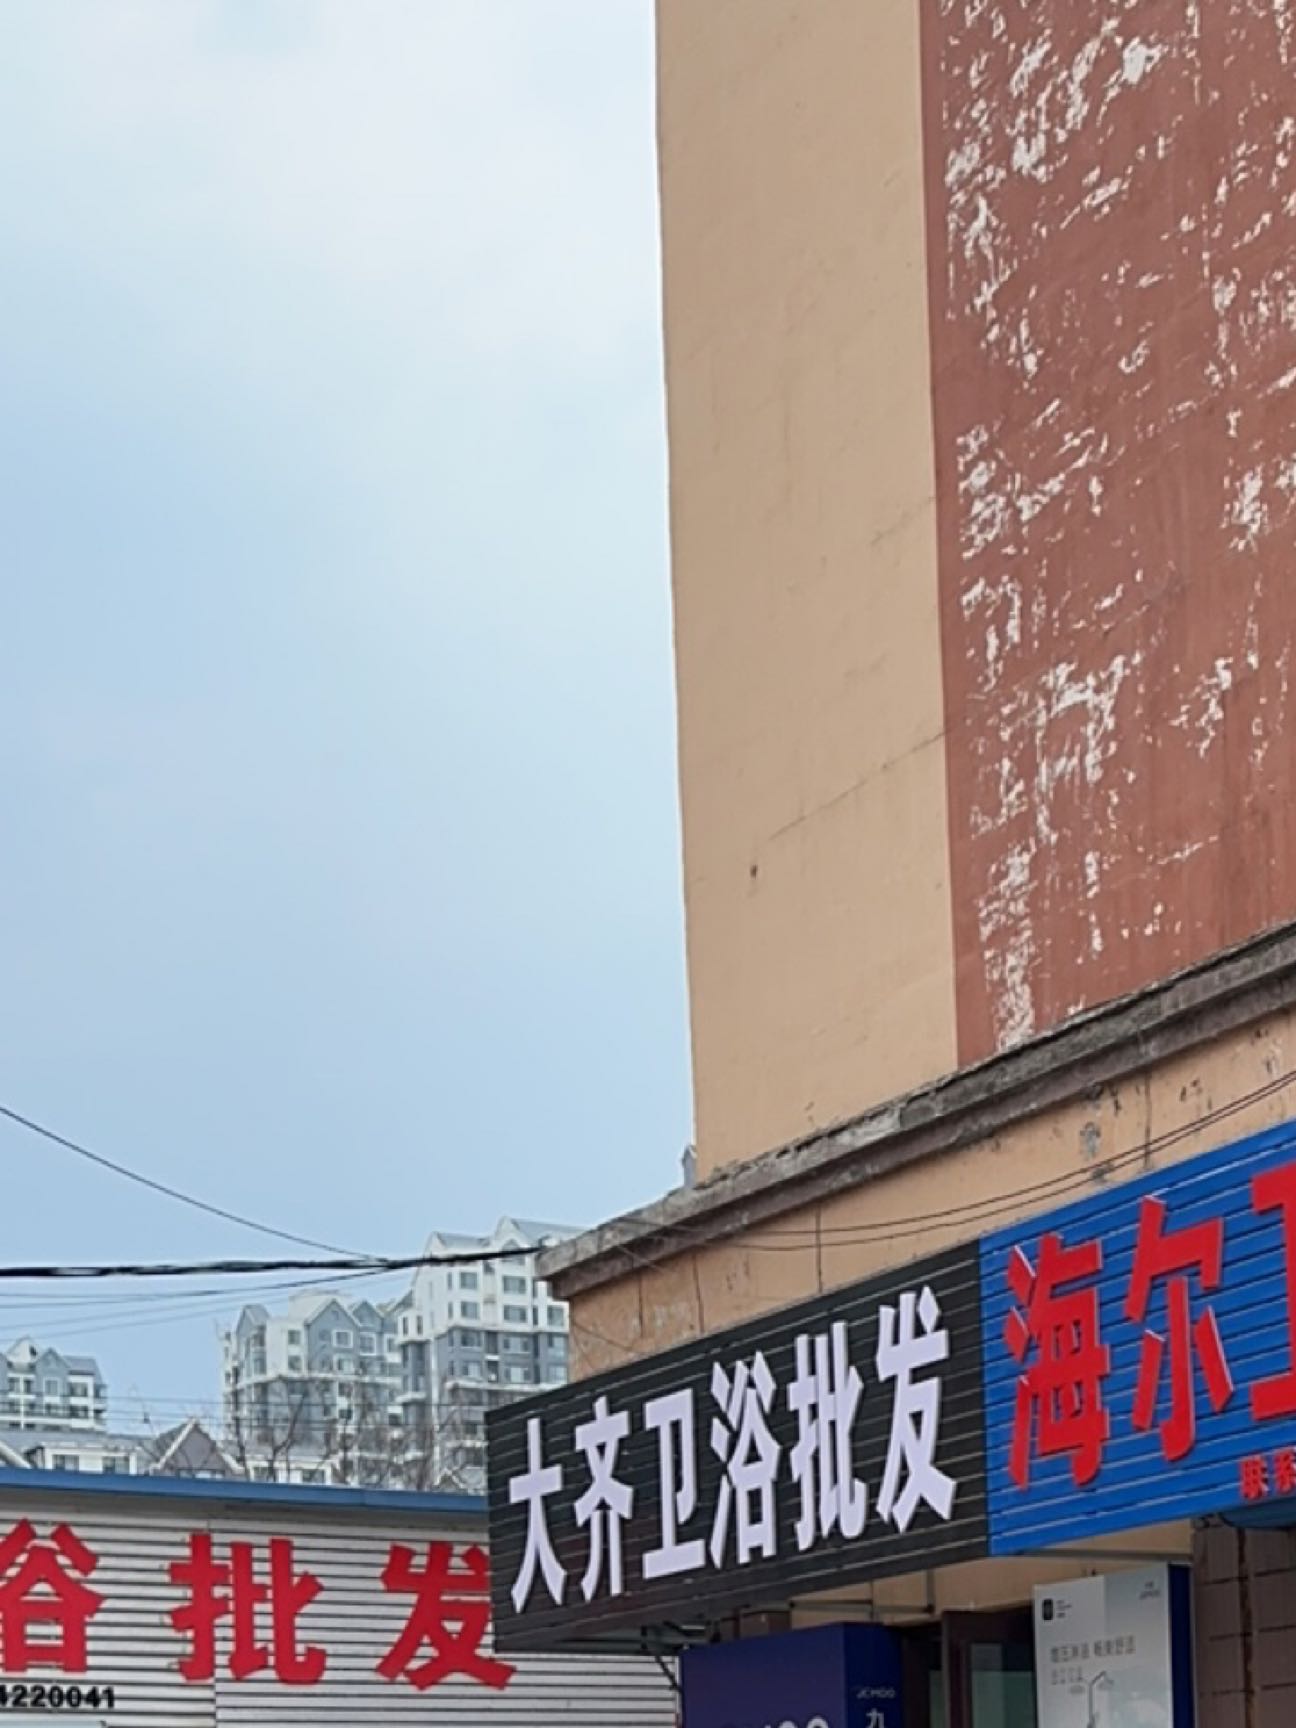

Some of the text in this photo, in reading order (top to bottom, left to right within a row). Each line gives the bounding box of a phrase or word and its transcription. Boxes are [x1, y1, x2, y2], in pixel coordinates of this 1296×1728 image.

[509, 1286, 957, 1613] 大齐卫浴批发
